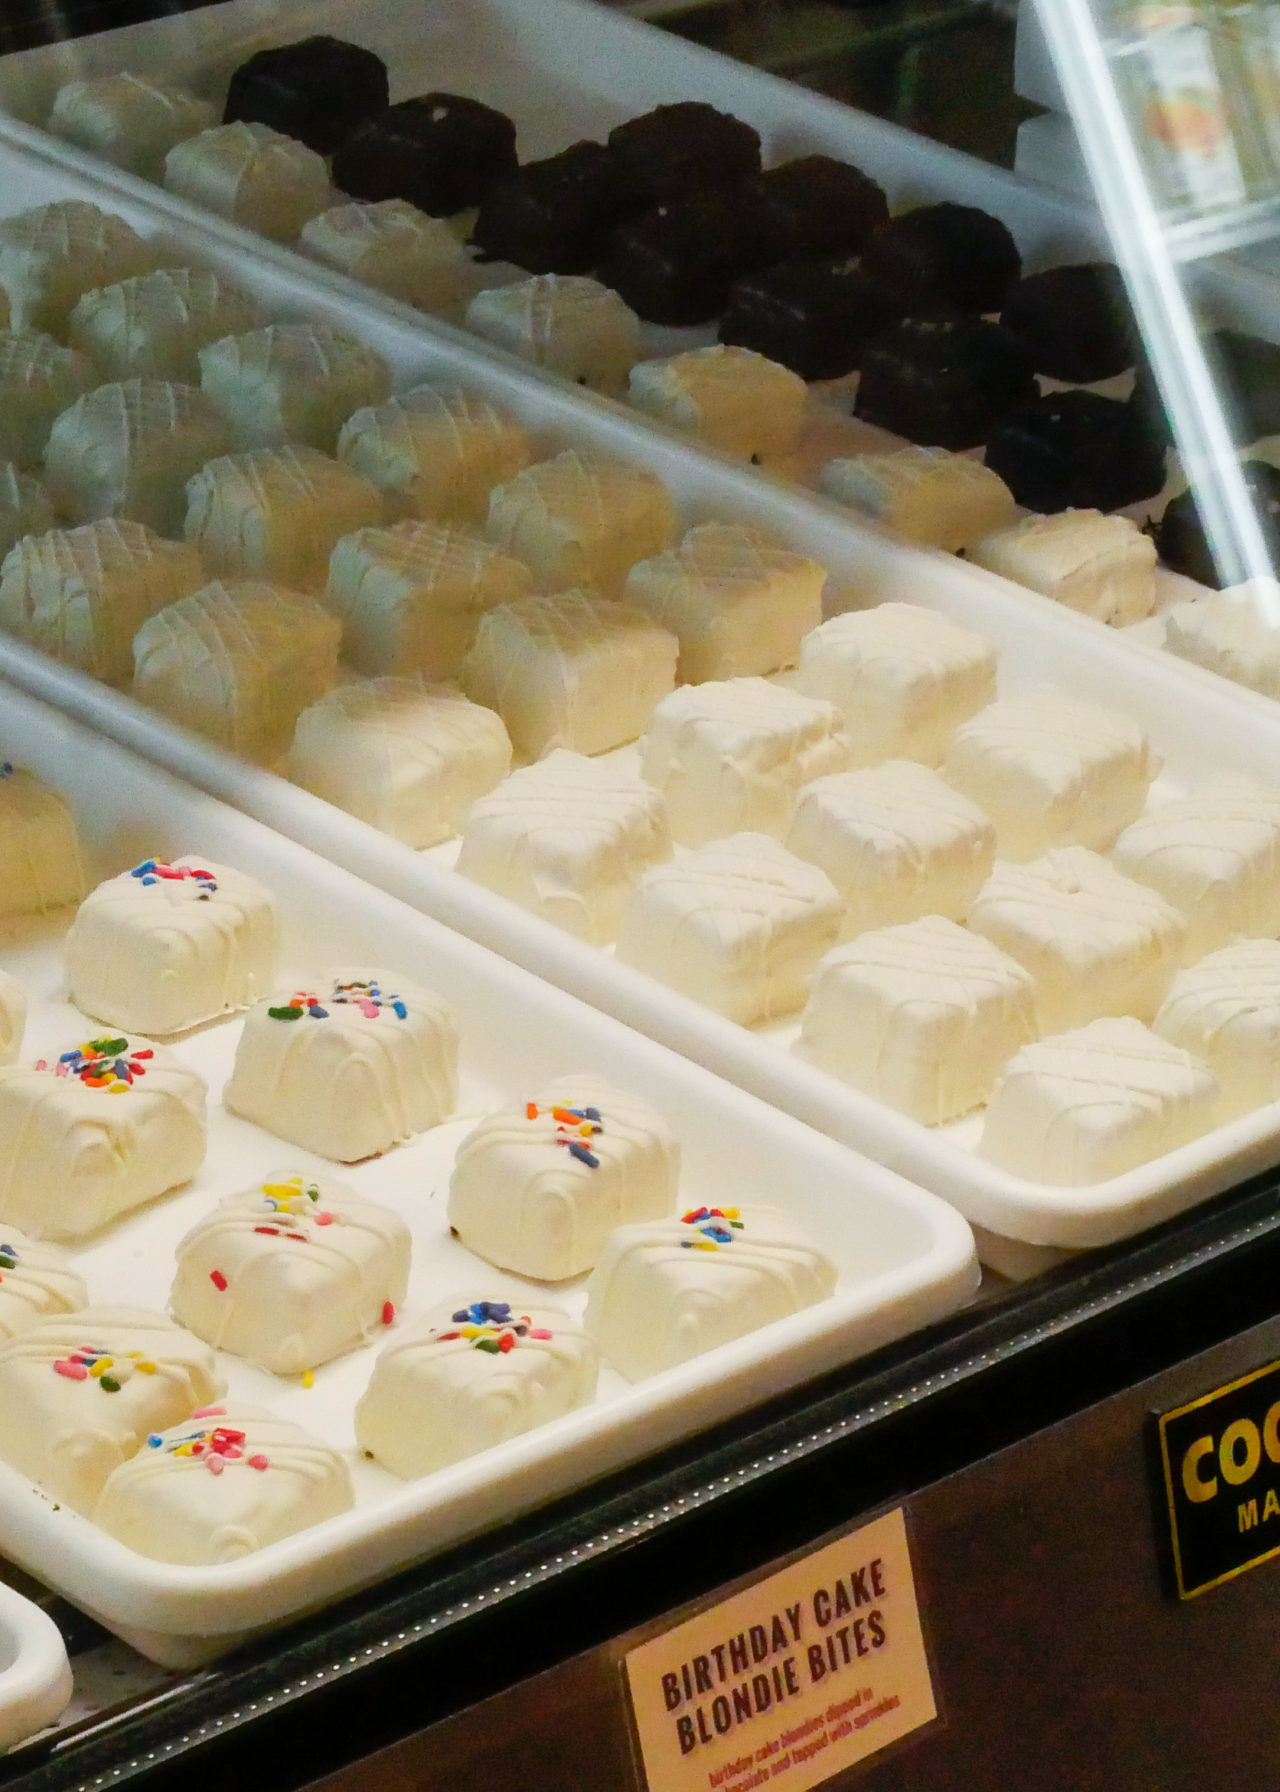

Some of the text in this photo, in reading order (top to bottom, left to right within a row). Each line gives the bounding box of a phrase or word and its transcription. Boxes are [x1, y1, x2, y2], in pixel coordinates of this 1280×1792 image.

[1237, 1489, 1280, 1533] MA
[661, 1558, 887, 1712] BIRTHDAY CAKE
[677, 1610, 887, 1756] BLONDIE BITES
[709, 1754, 753, 1788] birthday
[722, 1768, 770, 1792] colate
